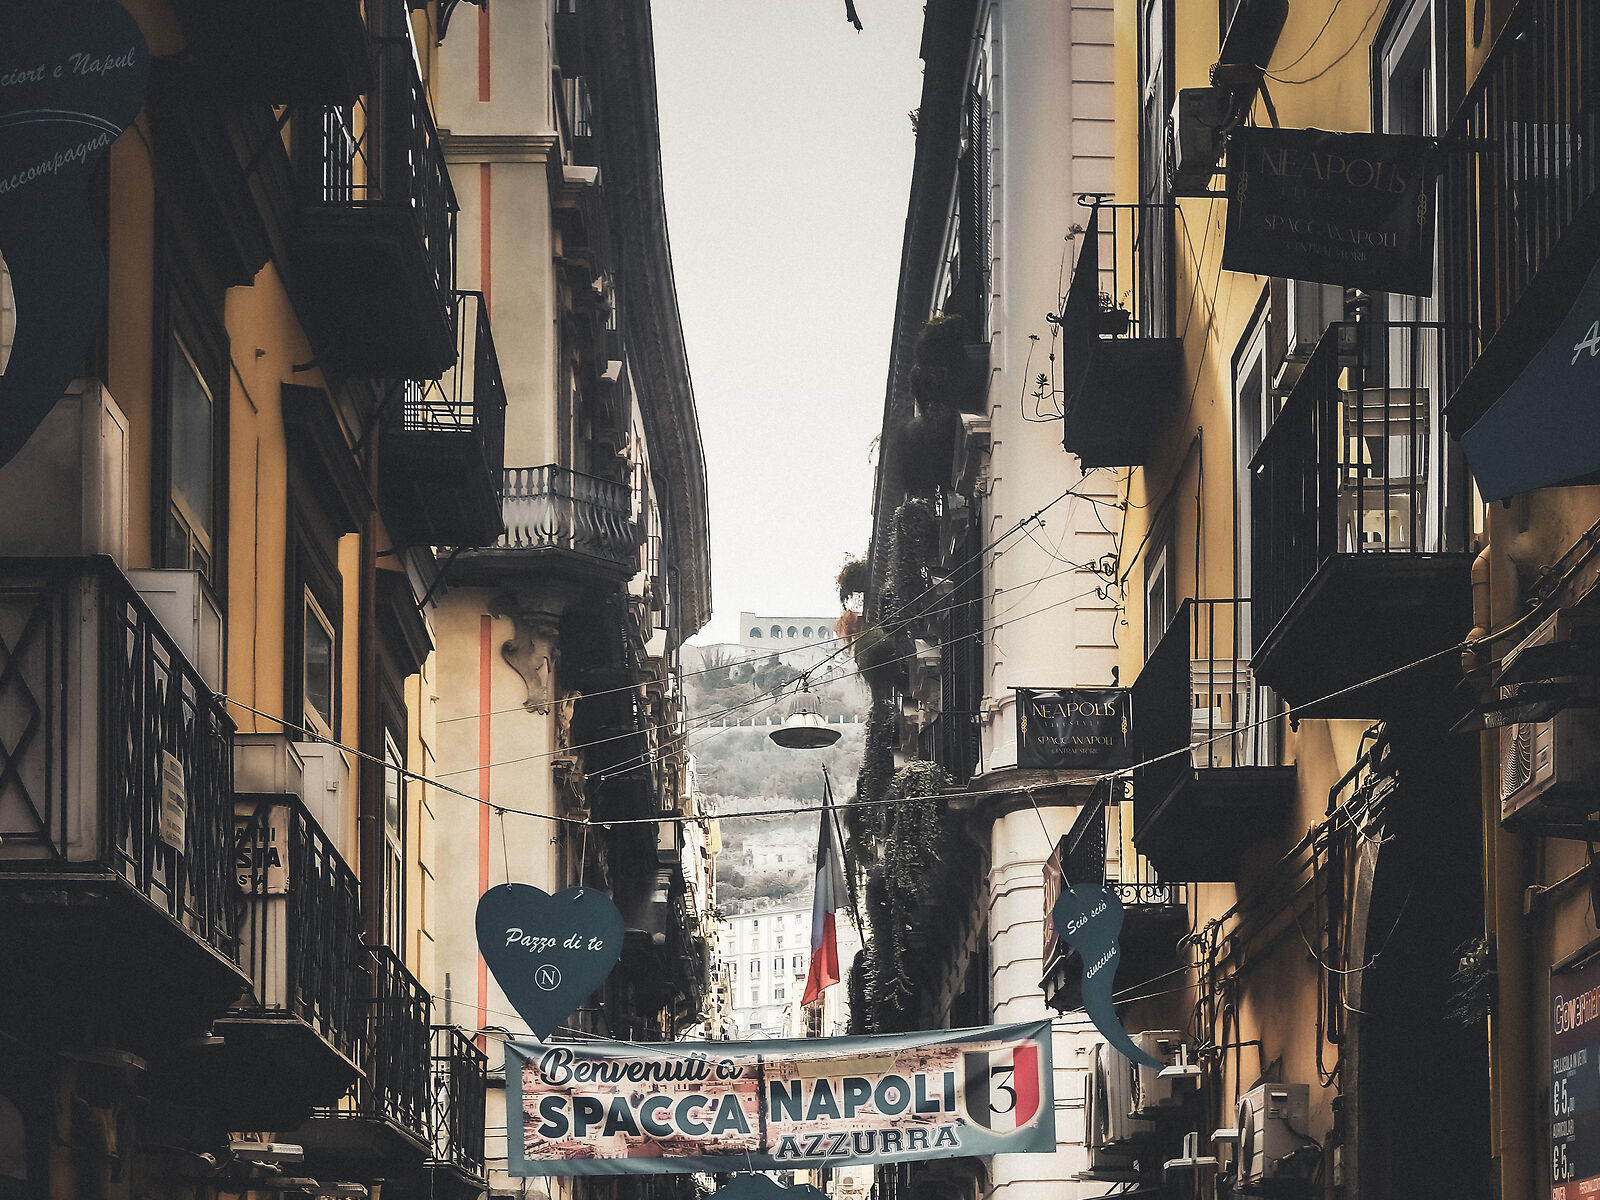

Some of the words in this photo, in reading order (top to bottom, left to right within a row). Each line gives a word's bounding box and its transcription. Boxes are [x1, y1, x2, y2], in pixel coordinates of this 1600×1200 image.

[53, 65, 63, 78] e
[68, 47, 136, 76] Napul
[0, 132, 110, 193] accompagna
[1261, 148, 1407, 194] NEAPOLIS
[1032, 702, 1117, 718] NEAPOLIS
[1067, 913, 1088, 935] Sciò
[1091, 899, 1107, 918] sciò
[505, 927, 556, 953] Pazzo
[563, 933, 583, 949] di
[587, 936, 603, 951] te
[541, 969, 556, 986] N
[540, 1047, 711, 1086] Benvenuti
[716, 1058, 744, 1080] a
[537, 1094, 750, 1138] SPACCA
[769, 1071, 956, 1122] NAPOLI
[988, 1066, 1018, 1114] 3
[1553, 1080, 1560, 1116] €
[775, 1126, 960, 1160] AZZURRA
[1553, 1145, 1560, 1181] €
